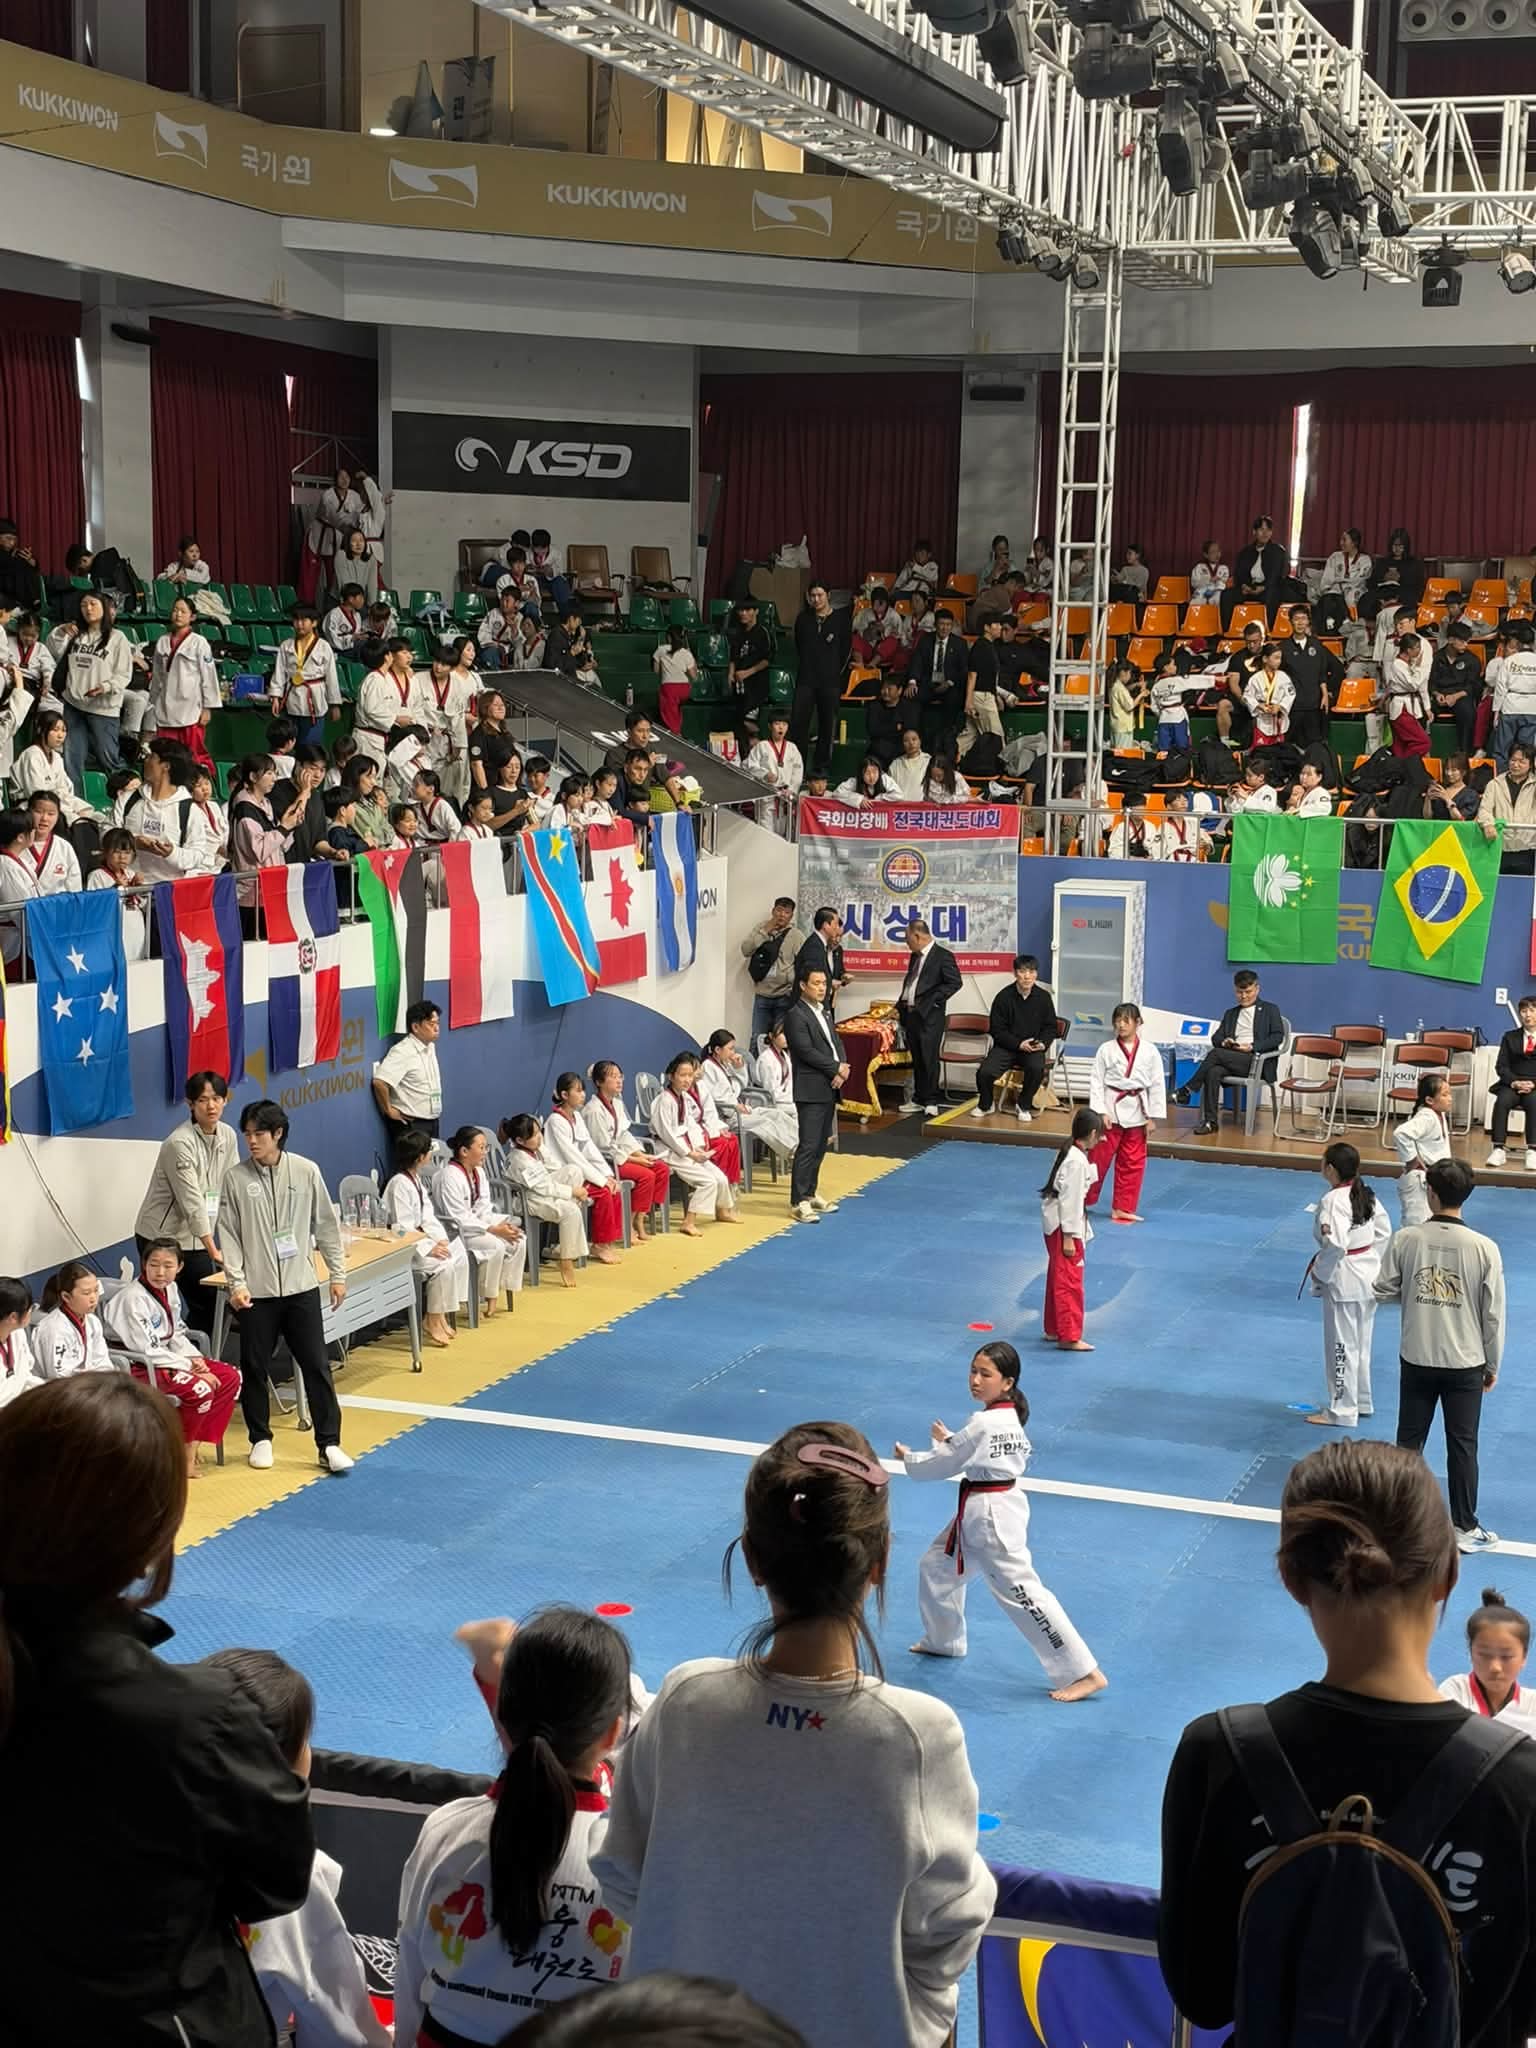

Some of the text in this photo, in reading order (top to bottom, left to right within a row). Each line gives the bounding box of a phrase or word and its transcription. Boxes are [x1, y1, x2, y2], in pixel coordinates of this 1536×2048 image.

[17, 83, 119, 133] KUKKIWON
[240, 143, 312, 186] 국기원
[546, 182, 688, 215] KUKKIWON
[895, 209, 979, 245] 국기원
[505, 439, 633, 480] KSD
[816, 809, 1002, 832] 국회의장배 전국태권도대회
[842, 902, 968, 944] 시상대
[279, 1070, 366, 1110] KUKKIWON
[766, 1702, 812, 1731] NY
